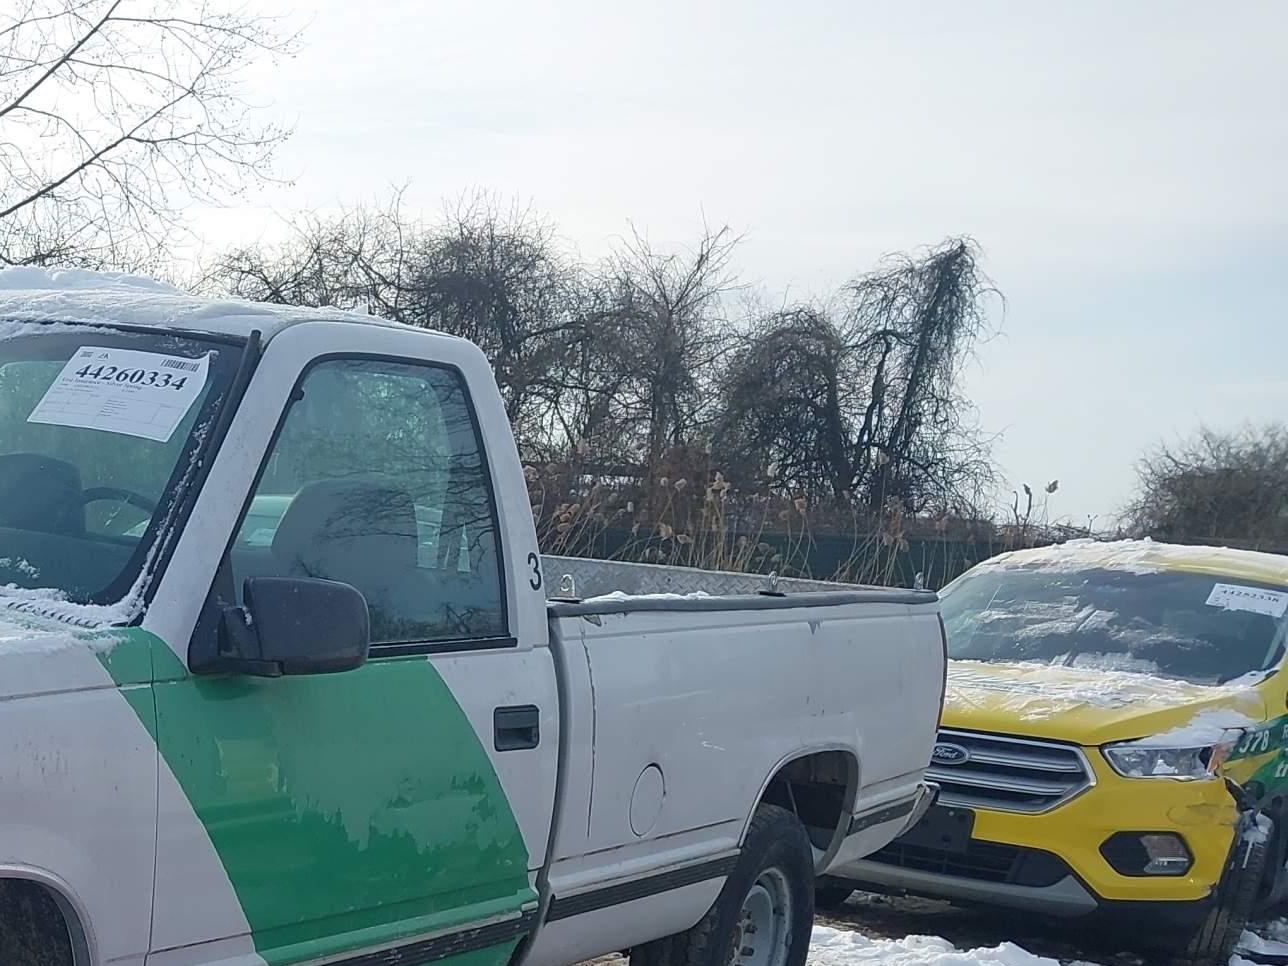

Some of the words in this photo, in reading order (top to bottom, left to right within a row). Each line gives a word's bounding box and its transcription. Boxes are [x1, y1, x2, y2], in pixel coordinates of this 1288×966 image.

[76, 364, 188, 391] 44260334
[527, 552, 542, 591] 3
[933, 746, 958, 759] Ford
